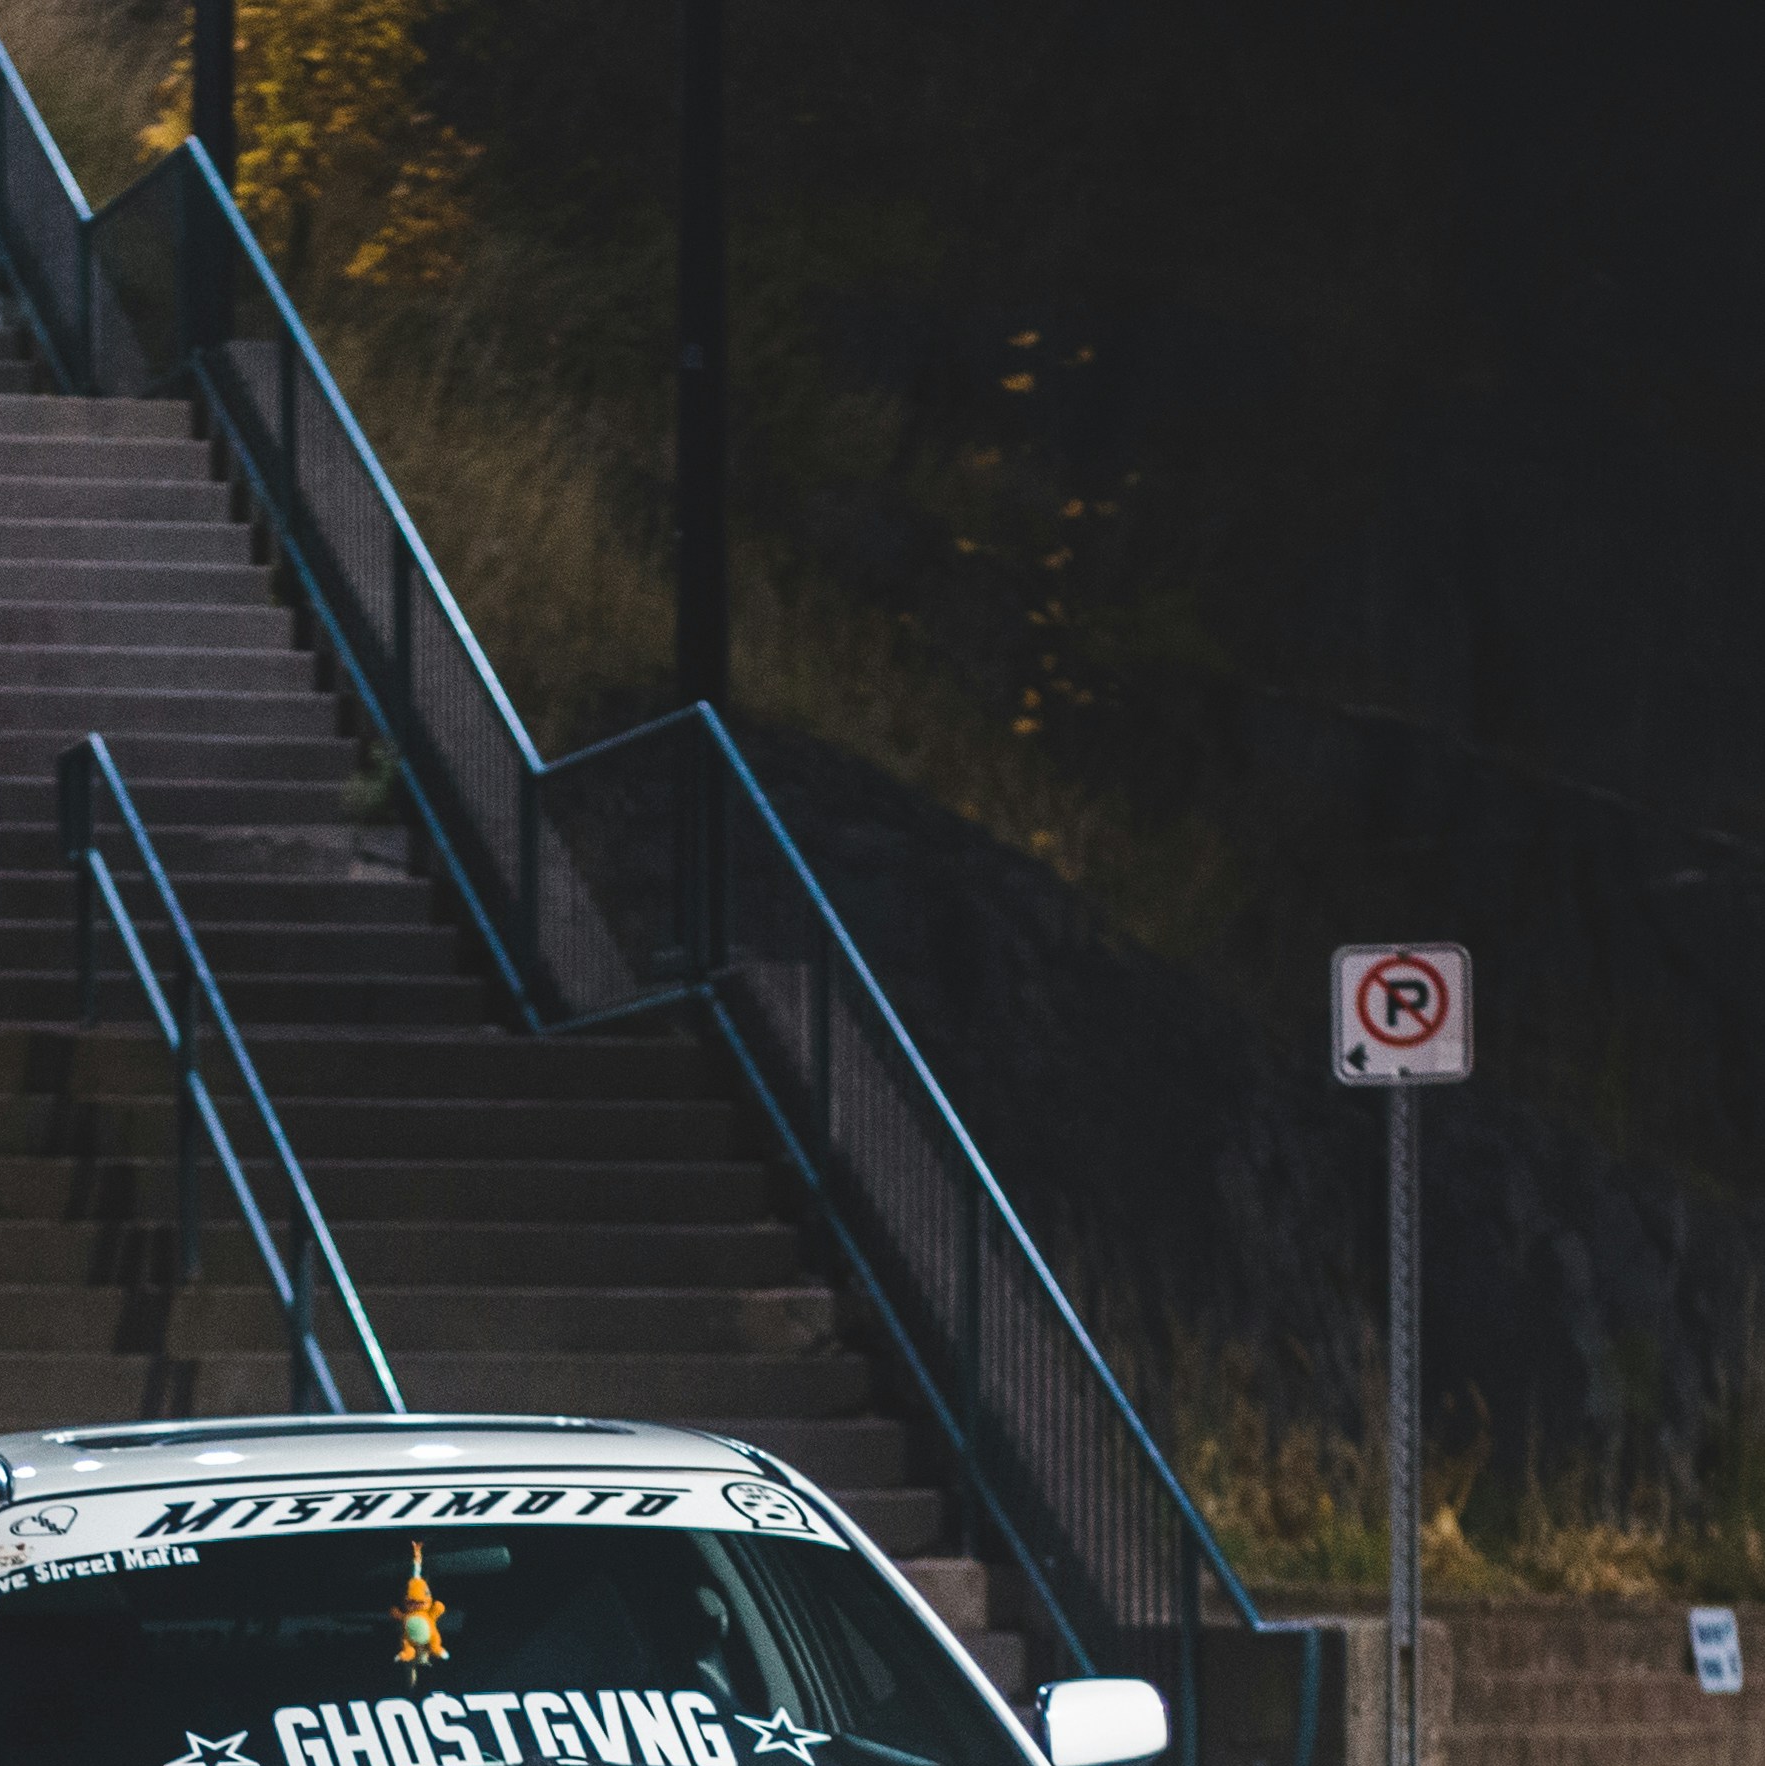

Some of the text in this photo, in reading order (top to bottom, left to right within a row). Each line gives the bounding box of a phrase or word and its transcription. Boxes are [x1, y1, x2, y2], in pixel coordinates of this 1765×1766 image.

[1386, 978, 1430, 1027] P
[135, 1487, 681, 1540] MISHIMOTO
[34, 1552, 118, 1585] Street
[121, 1544, 201, 1571] Mafia
